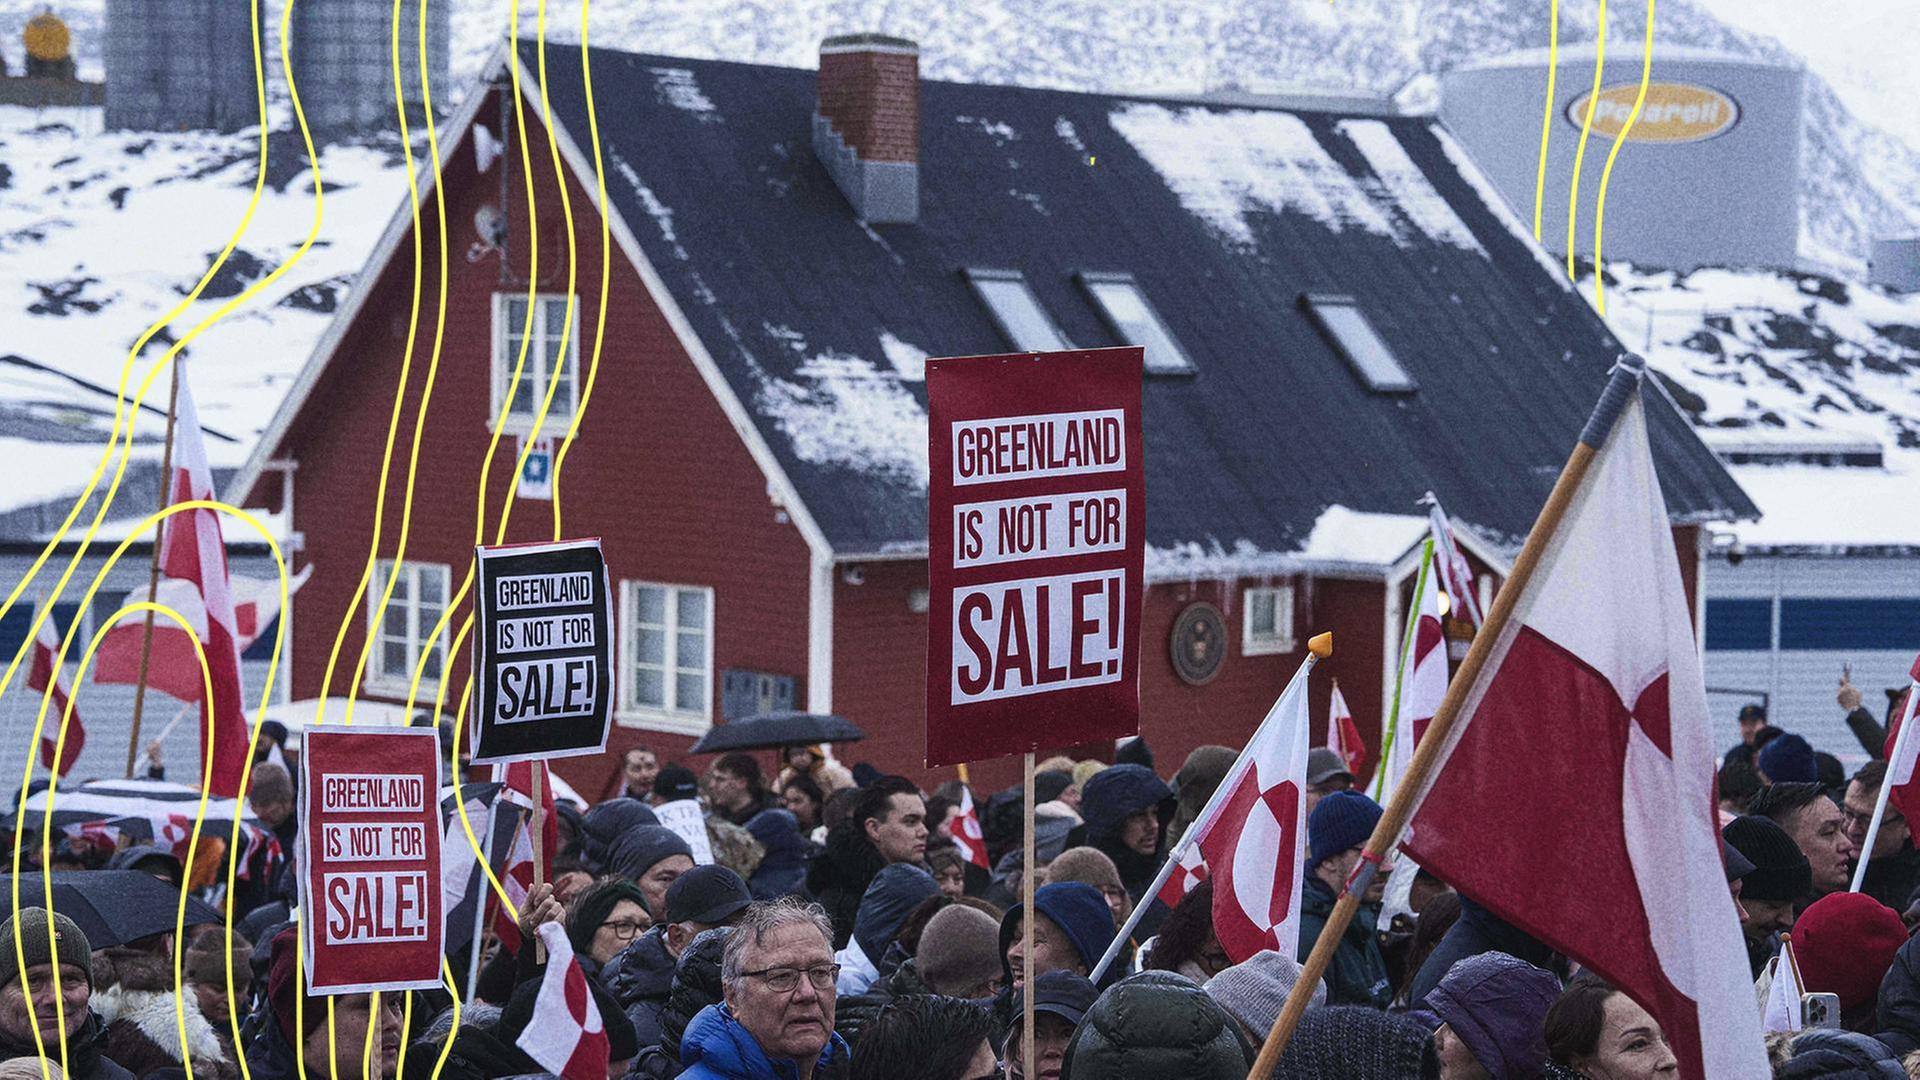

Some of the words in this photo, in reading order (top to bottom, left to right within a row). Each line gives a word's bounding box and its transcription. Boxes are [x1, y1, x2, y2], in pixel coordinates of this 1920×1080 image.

[958, 417, 1121, 478] GREENLAND
[959, 510, 983, 560] IS
[998, 503, 1052, 555] NOT
[1069, 497, 1121, 547] FOR
[500, 576, 590, 607] GREENLAND
[500, 623, 515, 649] IS
[523, 621, 553, 647] NOT
[562, 618, 591, 644] FOR
[957, 577, 1120, 695] SALE!
[499, 660, 594, 720] SALE!
[326, 778, 421, 808] GREENLAND
[326, 827, 342, 857] IS
[350, 827, 383, 857] NOT
[391, 827, 422, 856] FOR
[328, 876, 425, 940] SALE!
